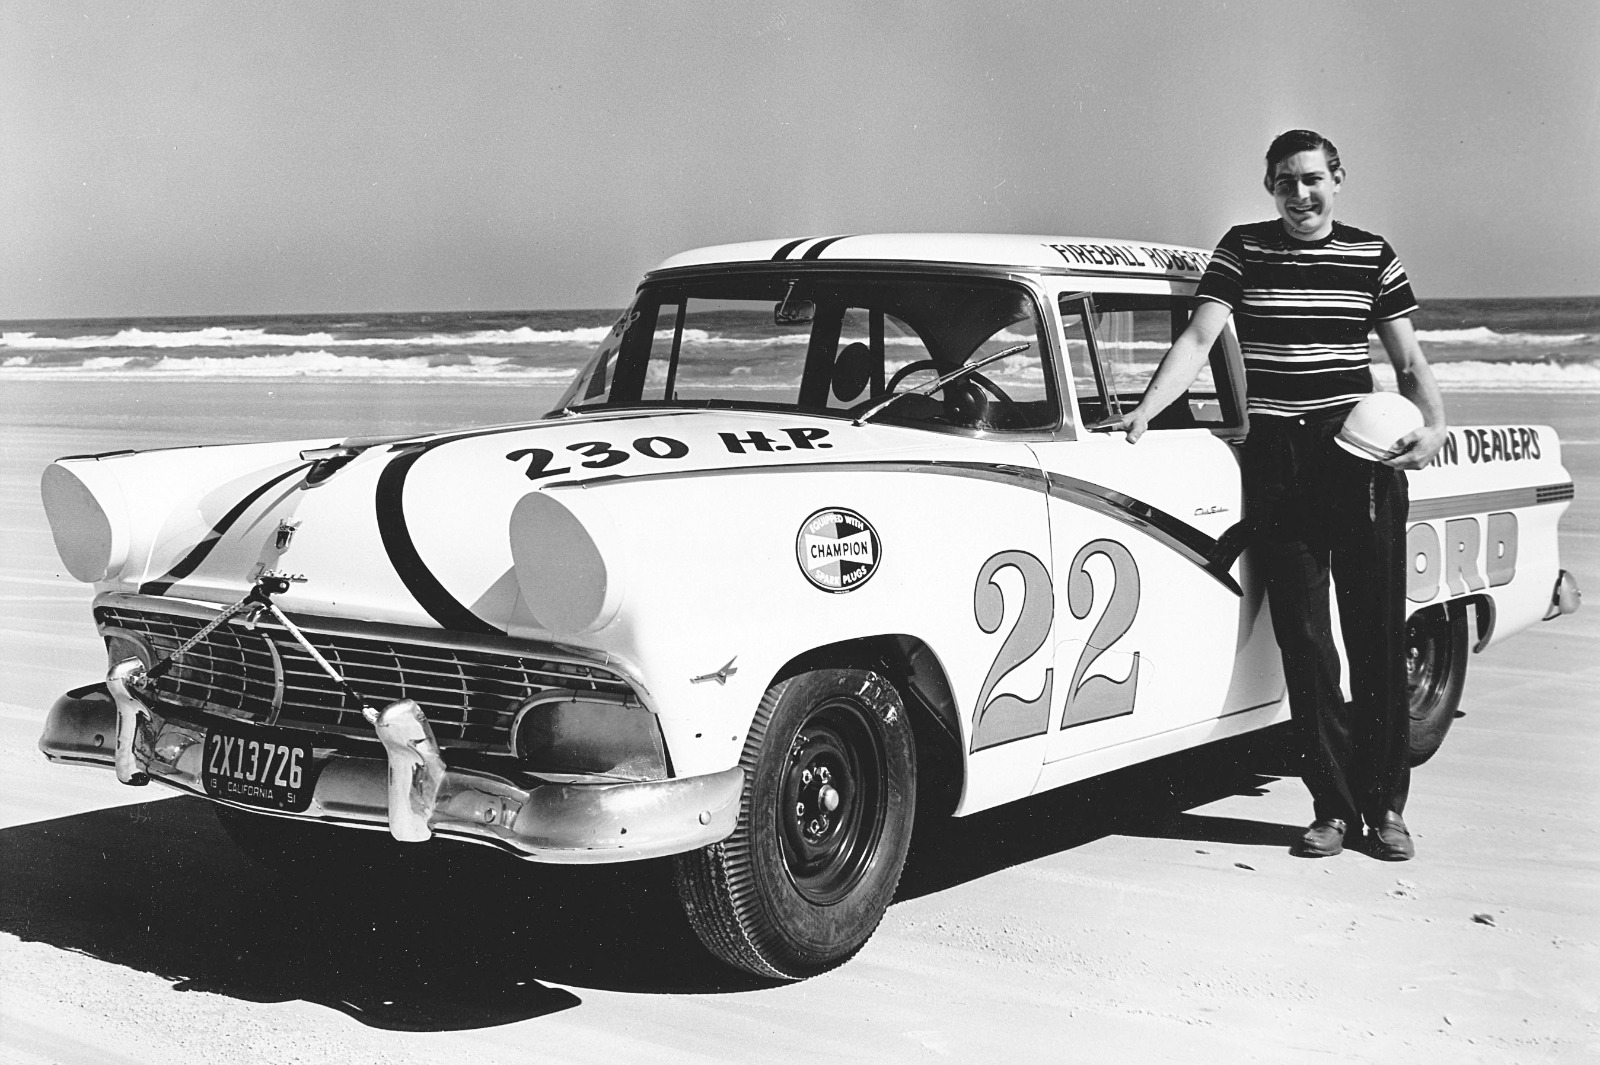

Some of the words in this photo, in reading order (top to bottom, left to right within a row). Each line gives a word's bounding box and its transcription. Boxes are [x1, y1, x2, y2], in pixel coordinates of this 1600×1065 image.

[506, 436, 689, 480] 230
[717, 428, 833, 454] H.P.
[1463, 427, 1541, 464] DEALERS
[808, 514, 844, 534] EQUIPPED
[844, 515, 864, 531] WITH
[810, 541, 868, 558] CHAMPION
[1406, 511, 1519, 604] ORD
[842, 565, 867, 584] PLUGS
[969, 537, 1141, 756] 22
[209, 734, 305, 789] 2X13726
[227, 781, 273, 800] CALIFORNIA
[287, 792, 297, 804] 51
